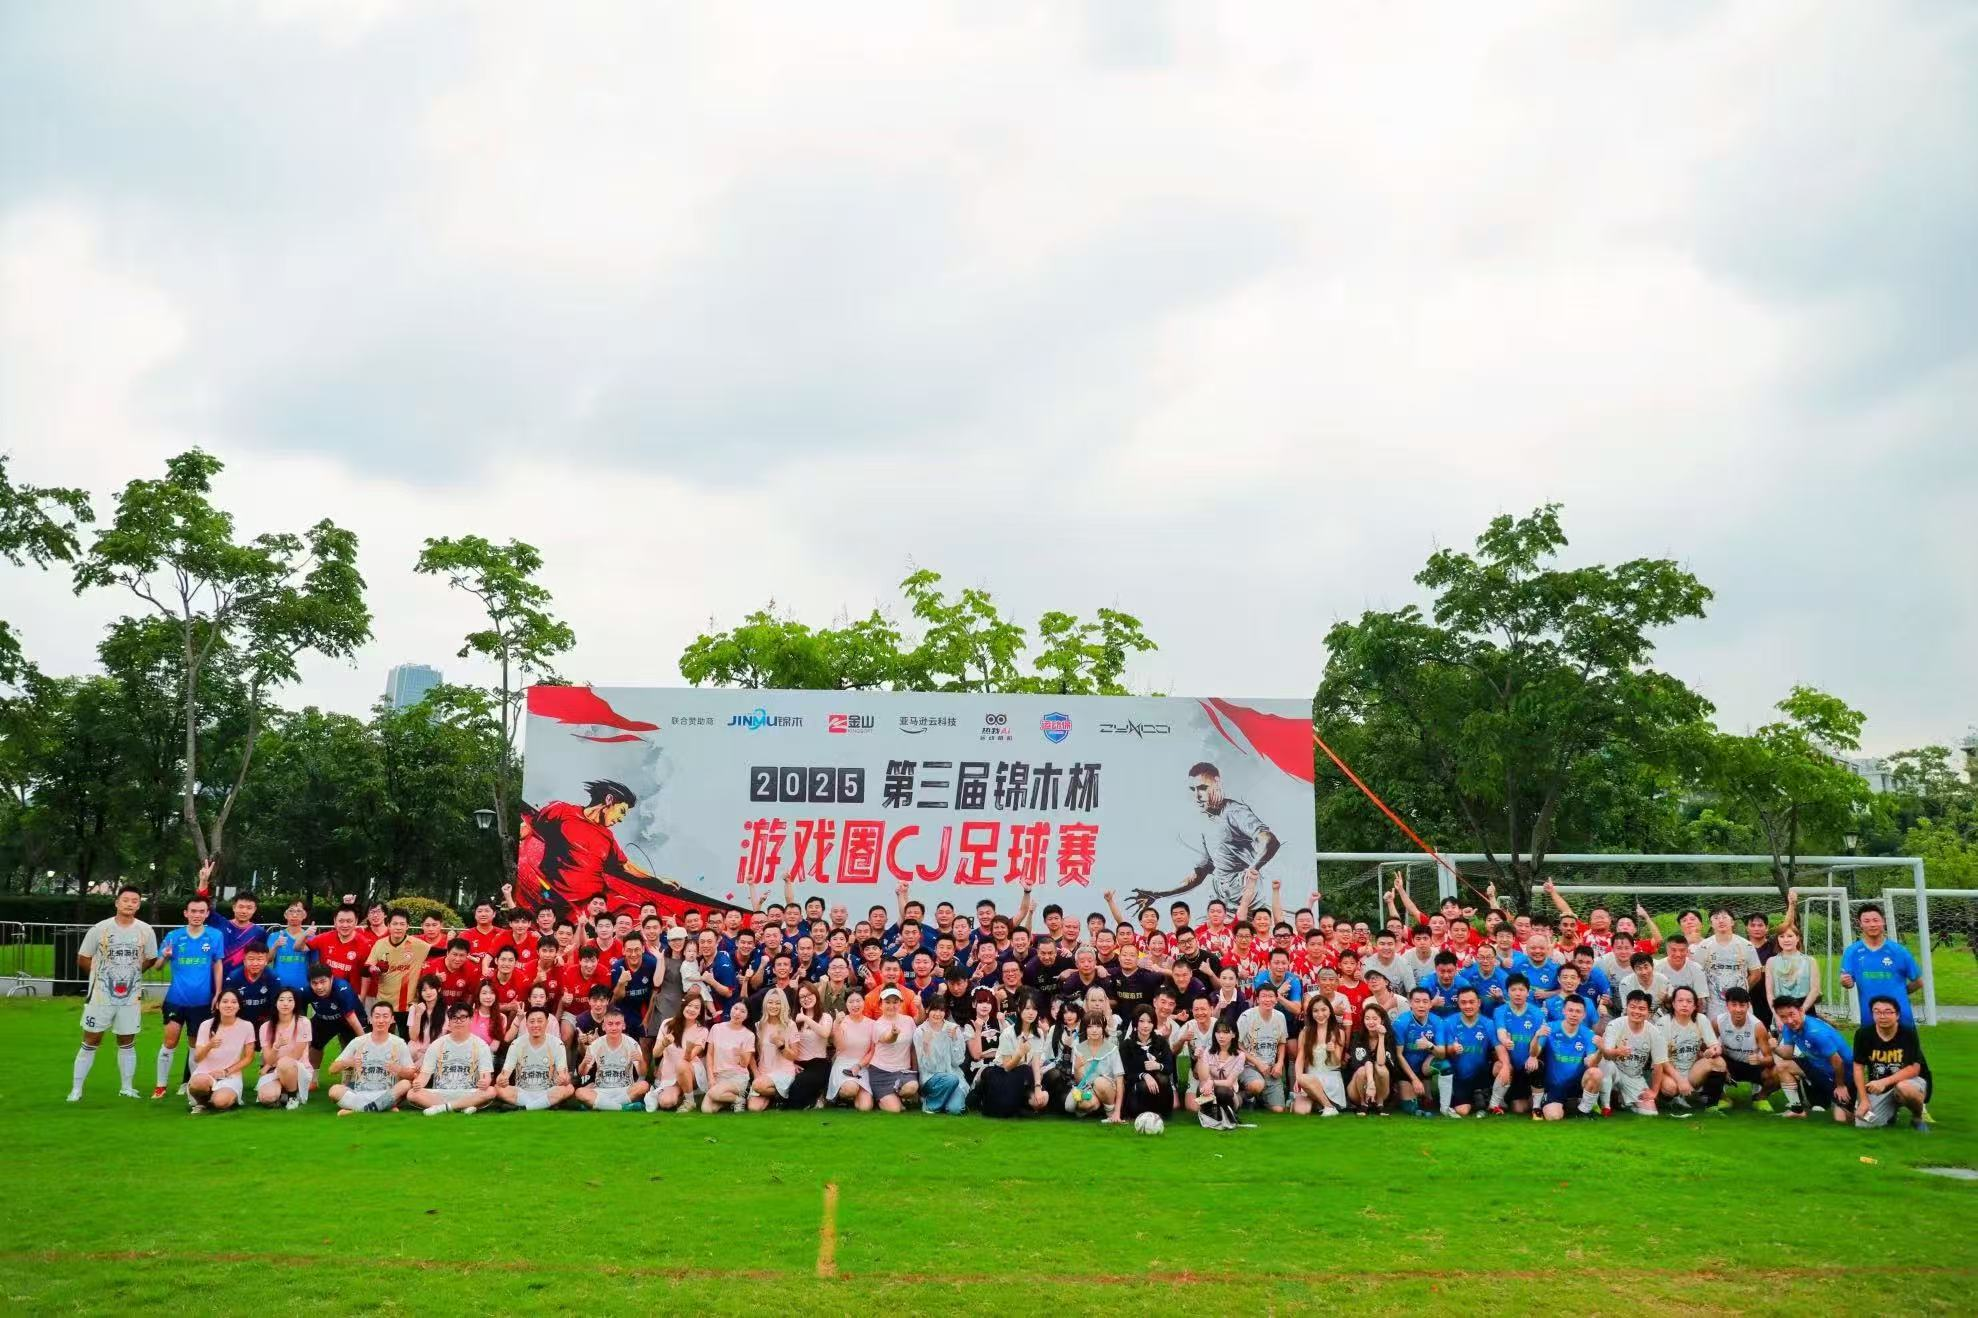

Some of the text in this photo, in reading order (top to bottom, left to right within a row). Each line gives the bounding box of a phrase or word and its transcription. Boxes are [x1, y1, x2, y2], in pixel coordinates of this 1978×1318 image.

[671, 716, 715, 726] 联合赞助商
[847, 714, 875, 729] 金山
[899, 716, 958, 727] 亚马逊云科技
[754, 759, 1103, 812] 2025 第三届锦木杯
[736, 817, 1101, 888] 游戏圈CJ足球赛
